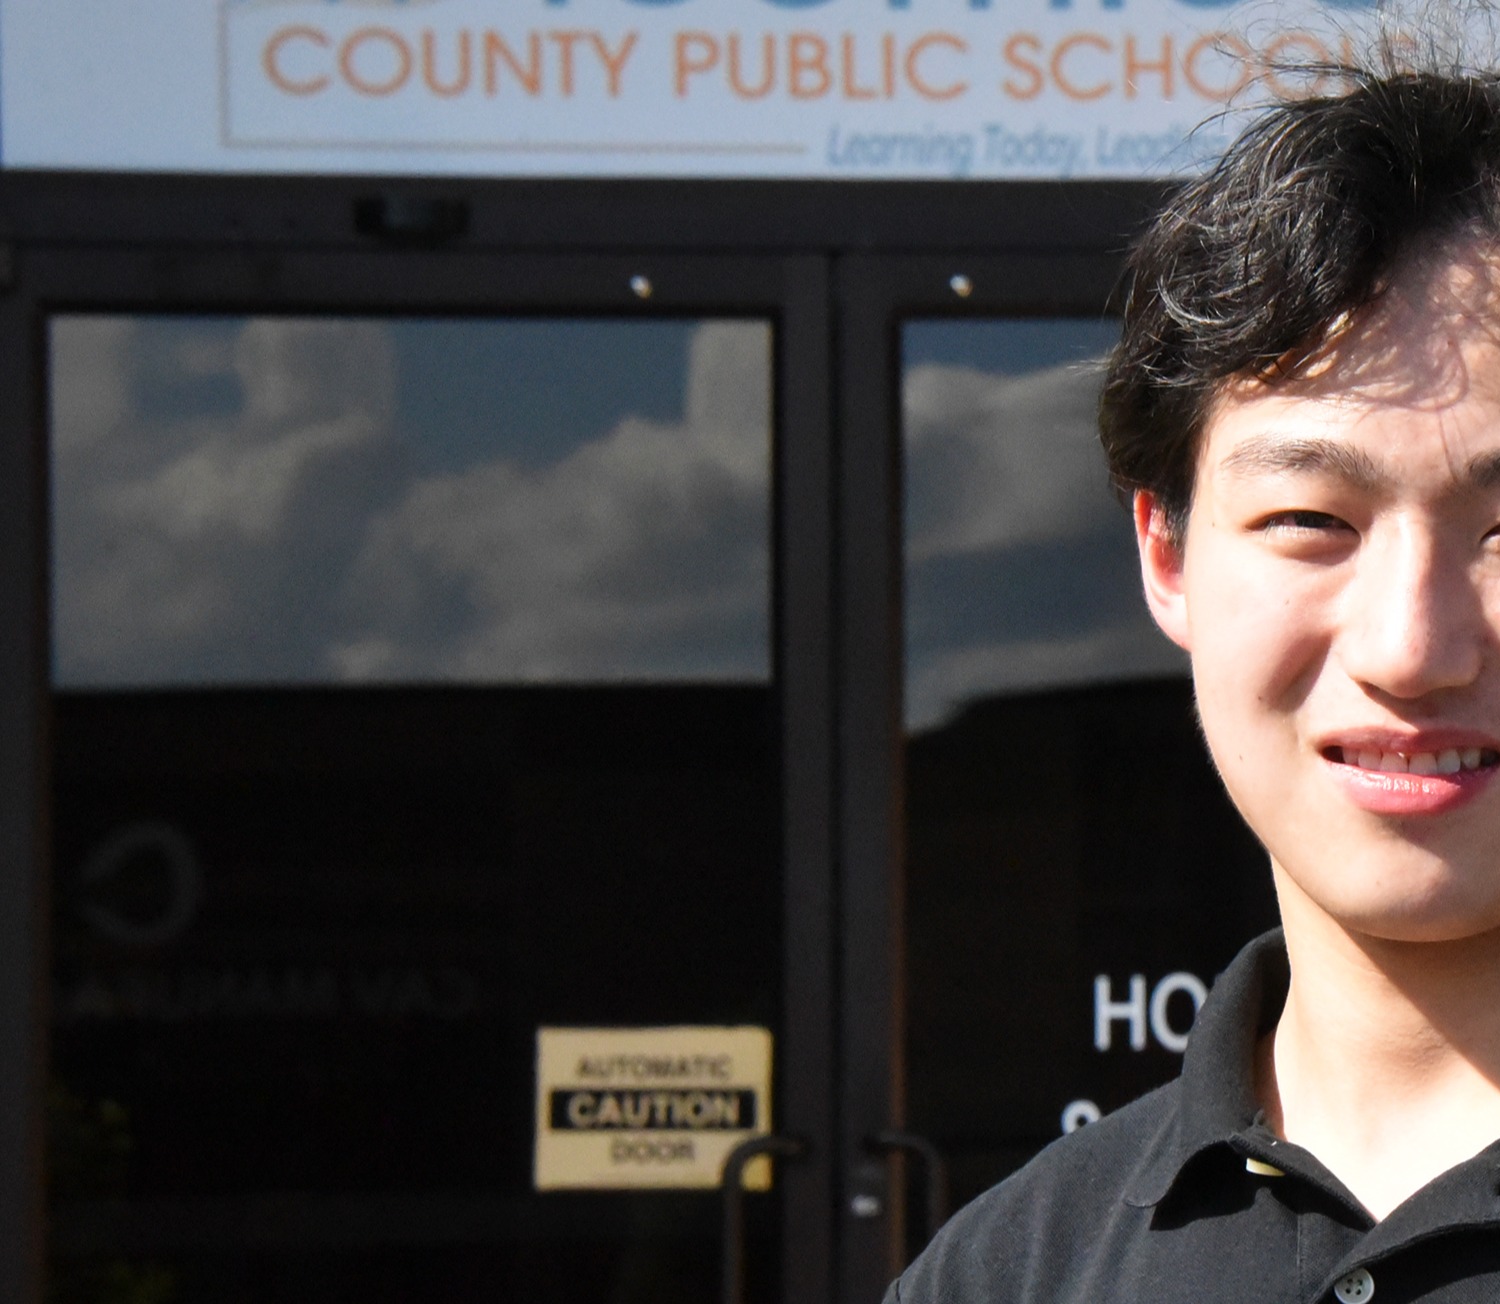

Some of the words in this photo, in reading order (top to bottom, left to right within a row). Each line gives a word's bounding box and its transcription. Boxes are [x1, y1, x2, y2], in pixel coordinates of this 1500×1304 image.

[262, 24, 640, 98] COUNTY
[672, 31, 970, 102] PUBLIC
[826, 122, 974, 178] Learning
[1093, 971, 1208, 1053] HO
[576, 1054, 732, 1079] AUTOMATIC
[567, 1092, 741, 1128] CAUTION
[611, 1139, 696, 1166] DOOR
